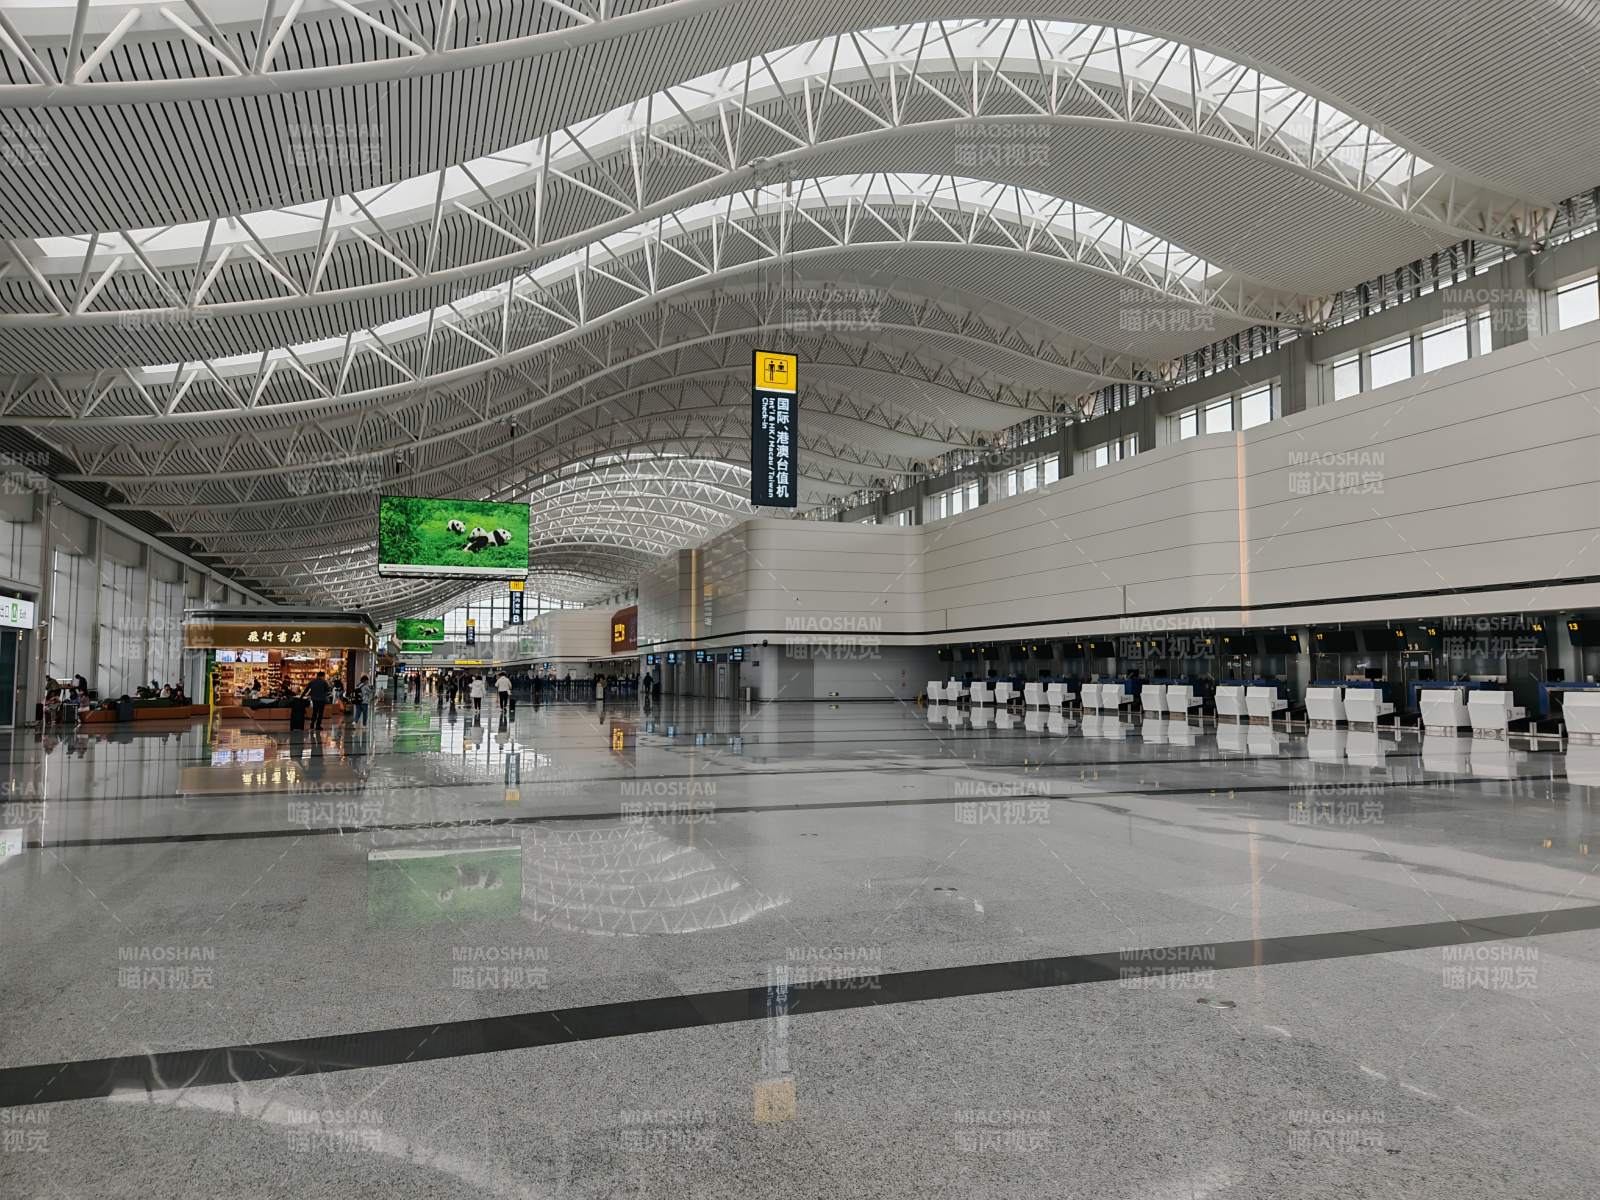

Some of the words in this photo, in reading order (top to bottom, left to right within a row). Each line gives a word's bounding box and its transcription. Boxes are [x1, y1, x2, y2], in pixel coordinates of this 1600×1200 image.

[776, 397, 790, 498] 国际、港澳台值机
[1532, 624, 1543, 632] 14
[1567, 622, 1579, 631] 13
